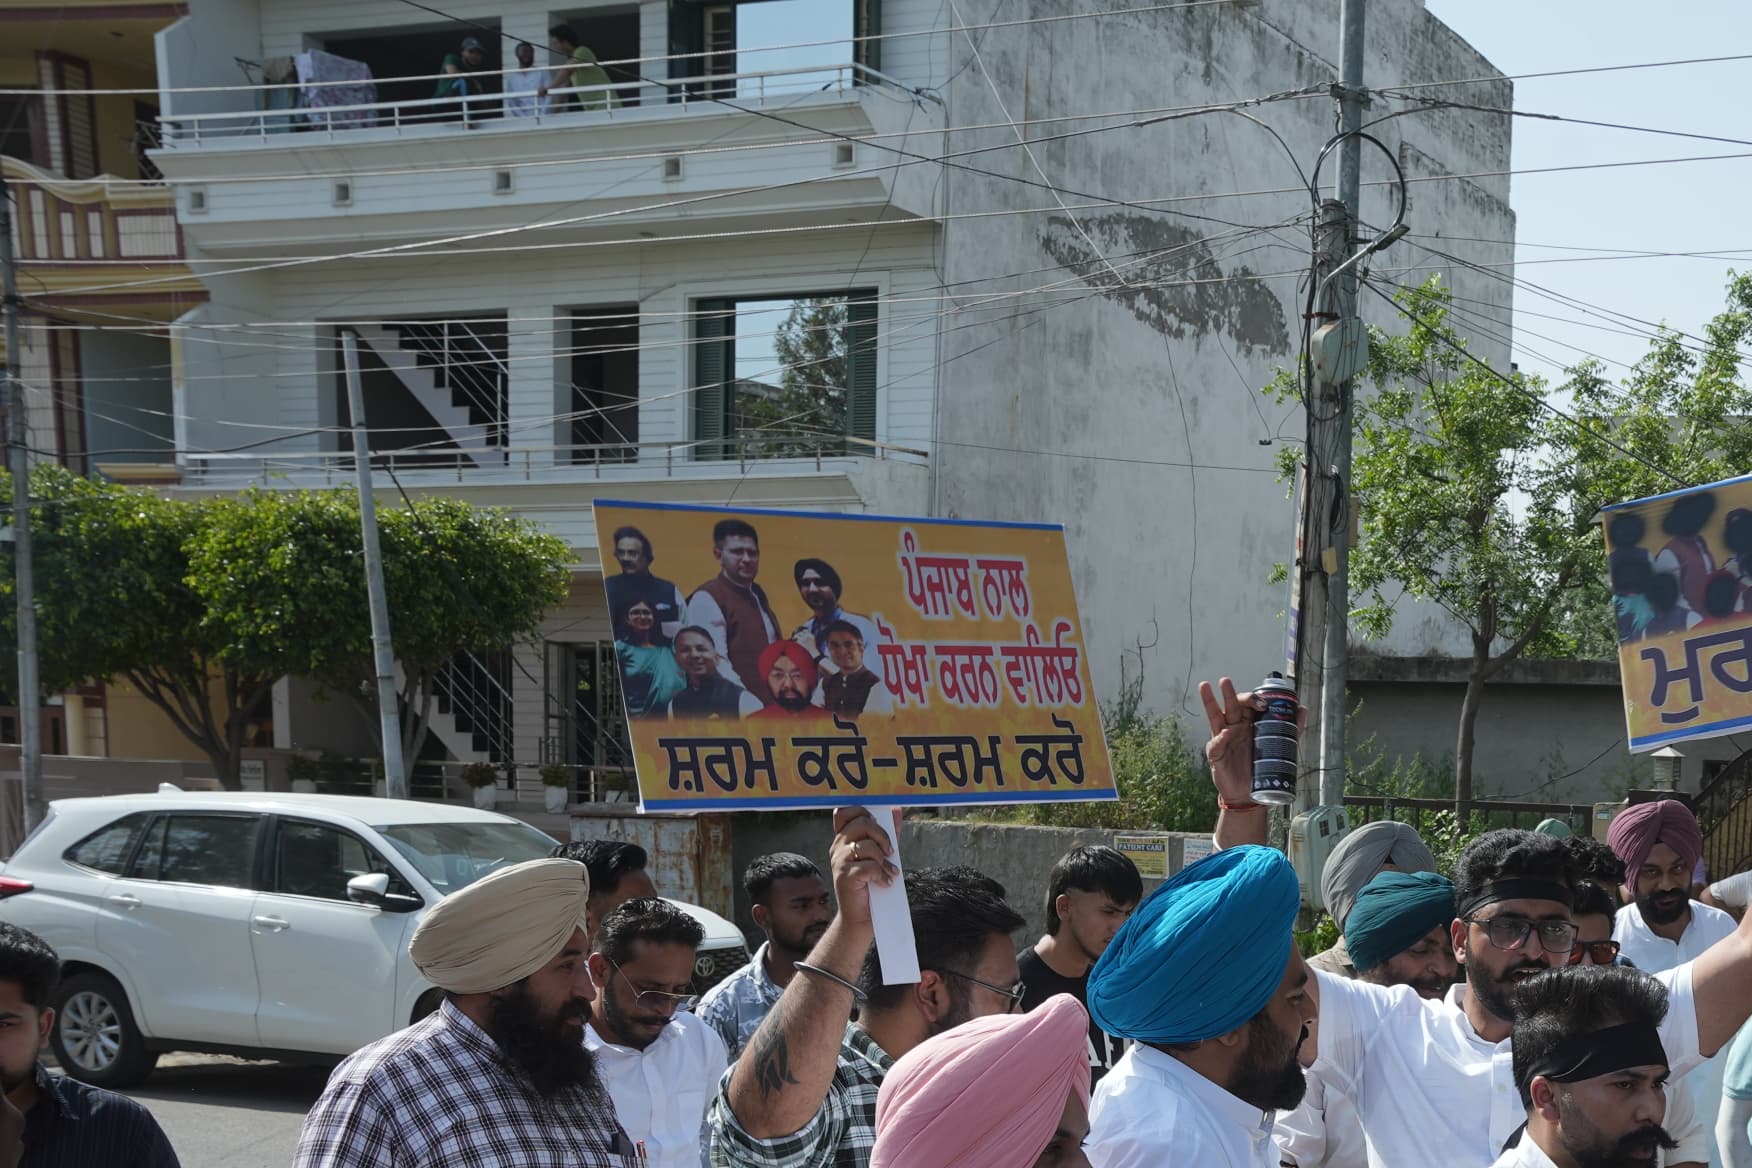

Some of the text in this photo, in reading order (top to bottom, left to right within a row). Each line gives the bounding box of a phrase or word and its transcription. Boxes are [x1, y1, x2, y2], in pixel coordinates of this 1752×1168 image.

[901, 531, 1030, 617] ਪੰਜਾਬ ਨਾਲ
[877, 617, 1082, 704] ਧੋਖਾ ਕਰਨ ਵਾਲਿਓ
[658, 738, 779, 793] ਸ਼ਰਮ
[1014, 712, 1085, 785] ਕਰੋ
